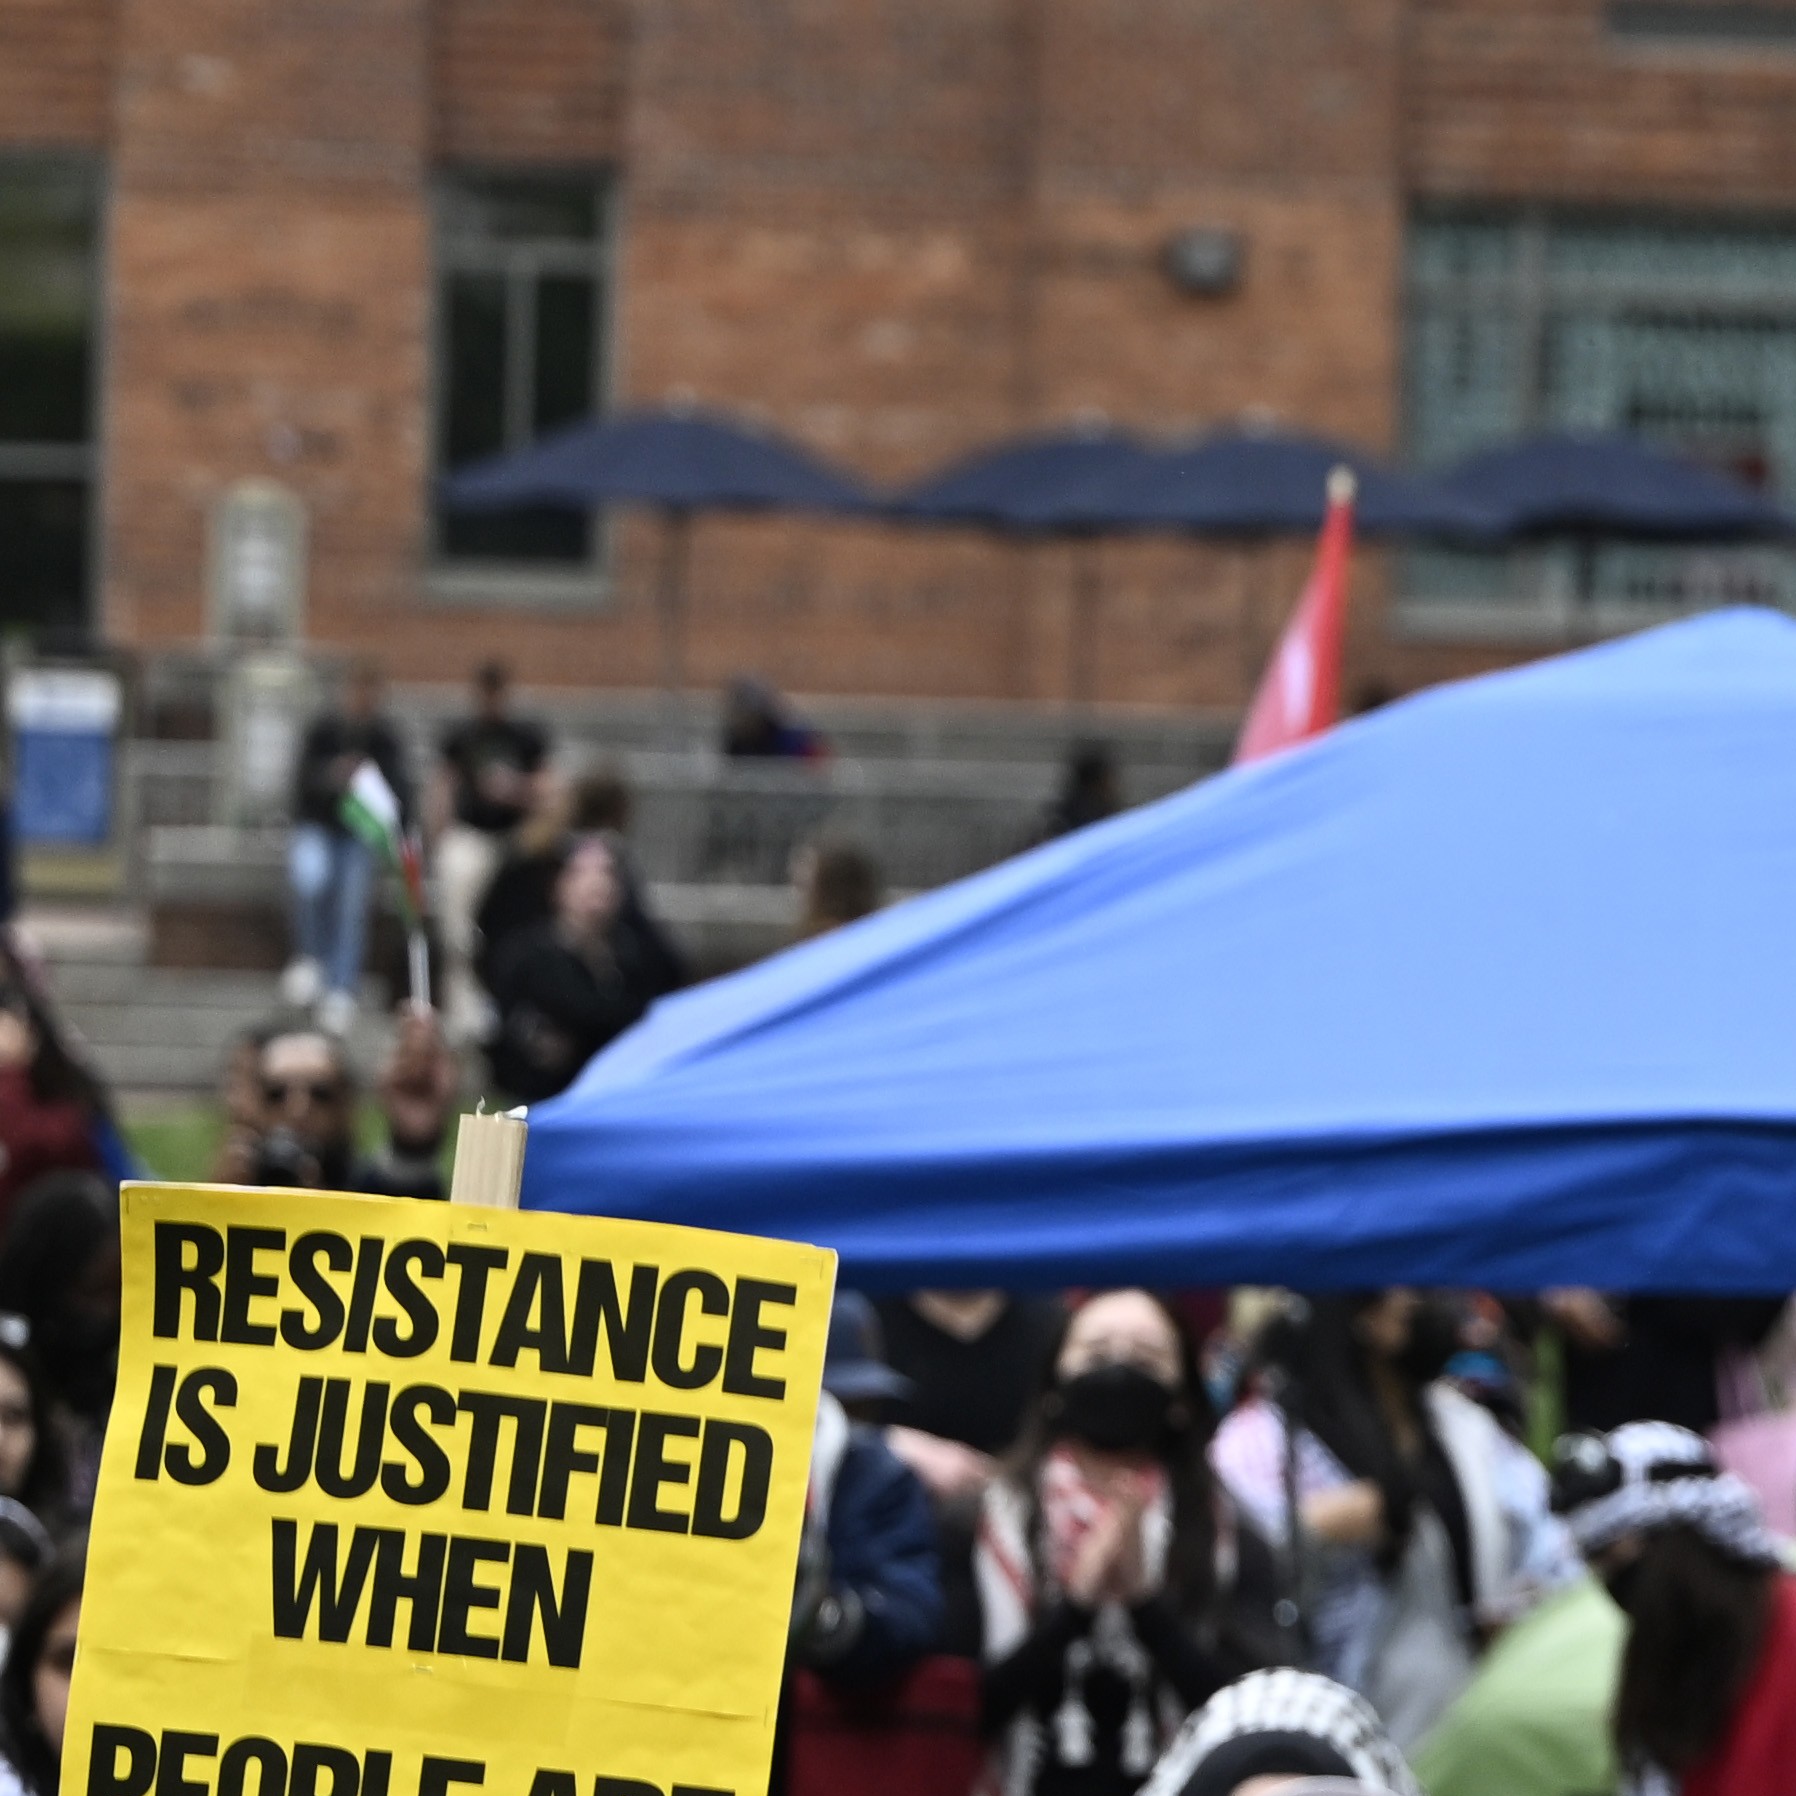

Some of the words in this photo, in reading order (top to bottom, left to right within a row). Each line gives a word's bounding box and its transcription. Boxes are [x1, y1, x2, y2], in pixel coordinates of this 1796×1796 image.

[153, 1221, 797, 1400] RESISTANCE
[135, 1364, 237, 1487] IS
[253, 1376, 771, 1541] JUSTIFIED
[271, 1518, 594, 1670] WHEN
